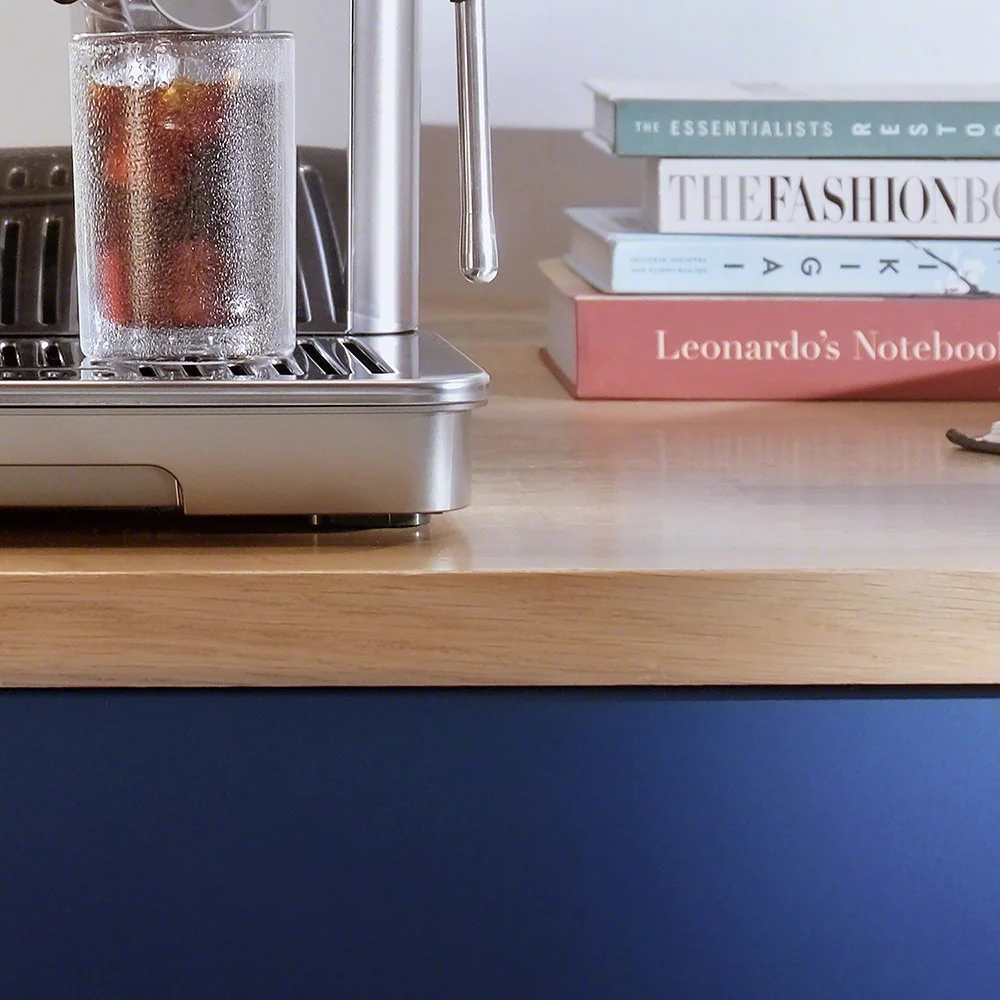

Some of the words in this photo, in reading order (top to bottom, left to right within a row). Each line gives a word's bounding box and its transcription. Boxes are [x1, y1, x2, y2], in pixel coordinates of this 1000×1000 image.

[634, 121, 660, 132] THE
[669, 120, 833, 137] ESSENTIALISTS
[853, 330, 1000, 361] Noteboo
